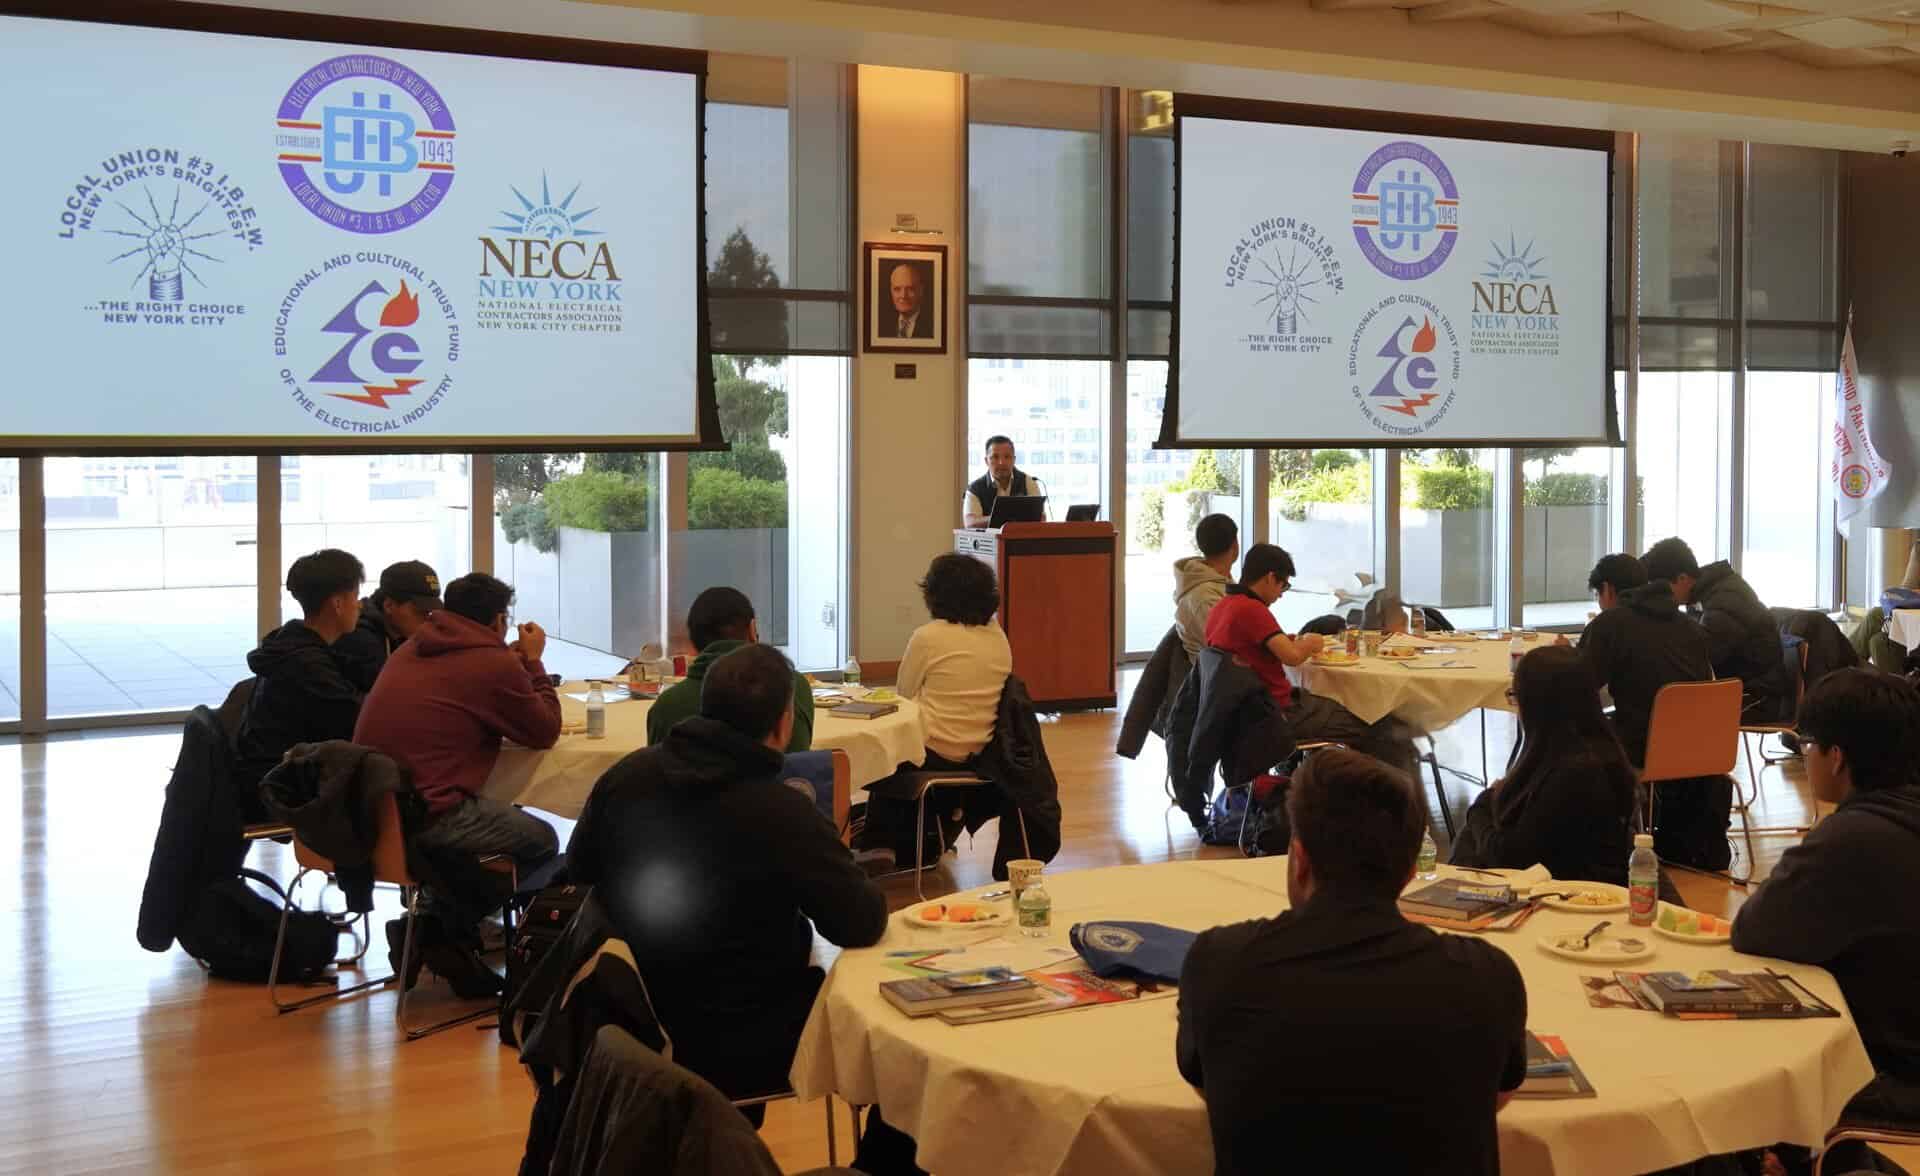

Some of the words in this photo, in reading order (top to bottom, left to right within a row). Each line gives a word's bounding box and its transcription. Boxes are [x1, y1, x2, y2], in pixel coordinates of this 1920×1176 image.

[330, 58, 391, 77] CONTRACTORS
[392, 69, 405, 81] OF
[404, 77, 423, 96] NEW
[420, 92, 442, 113] YORK
[421, 139, 454, 164] 1943
[58, 174, 102, 239] LOCAL
[102, 148, 180, 174] UNION
[187, 156, 215, 176] #3
[217, 174, 264, 252] I.B.E.W.
[78, 193, 103, 230] NEW
[101, 164, 166, 194] YORK'S
[172, 167, 246, 241] BRIGHTEST
[293, 182, 320, 208] LOCAL
[318, 201, 346, 224] UNION
[1439, 206, 1458, 225] 1943
[478, 237, 623, 281] NECA
[1225, 238, 1251, 288] LOCAL
[1250, 217, 1296, 238] UNION
[1300, 222, 1316, 238] #3
[1236, 252, 1251, 281] NEW
[1292, 231, 1334, 287] BRIGHTEST
[274, 268, 321, 356] EDUCATIONAL
[323, 254, 351, 273] AND
[356, 251, 425, 282] CULTURAL
[427, 279, 457, 320] TRUST
[447, 324, 460, 362] FUND
[477, 300, 543, 311] NATIONAL
[549, 302, 624, 313] ELECTRICAL
[479, 279, 538, 299] NEW
[549, 281, 623, 301] YORK
[1472, 281, 1560, 315] NECA
[104, 313, 138, 323] NEW
[144, 314, 185, 325] YORK
[191, 315, 225, 326] CITY
[135, 302, 183, 313] RIGHT
[189, 303, 245, 314] CHOICE
[477, 311, 553, 321] CONTRACTORS
[557, 312, 622, 323] ASSOCIATION
[1472, 314, 1506, 329] NEW
[1515, 316, 1559, 330] YORK
[477, 321, 502, 329] NEW
[506, 321, 538, 330] YORK
[542, 322, 567, 331] CITY
[571, 323, 623, 332] CHAPTER
[1269, 335, 1297, 343] RIGHT
[1299, 335, 1333, 344] CHOICE
[1349, 308, 1378, 376] EDUCATIONAL
[1379, 296, 1396, 310] AND
[1398, 294, 1440, 317] CULTURAL
[1440, 315, 1458, 348] TRUST
[1452, 350, 1461, 380] FUND
[1250, 343, 1270, 352] NEW
[1274, 344, 1298, 353] YORK
[1300, 344, 1321, 353] CITY
[280, 368, 296, 385] OF
[291, 386, 315, 413] THE
[315, 408, 401, 433] ELECTRICAL
[402, 373, 453, 425] INDUSTRY
[1352, 385, 1362, 399] OF
[1360, 400, 1373, 420] THE
[1372, 417, 1424, 436] ELECTRICAL
[1424, 388, 1457, 429] INDUSTRY
